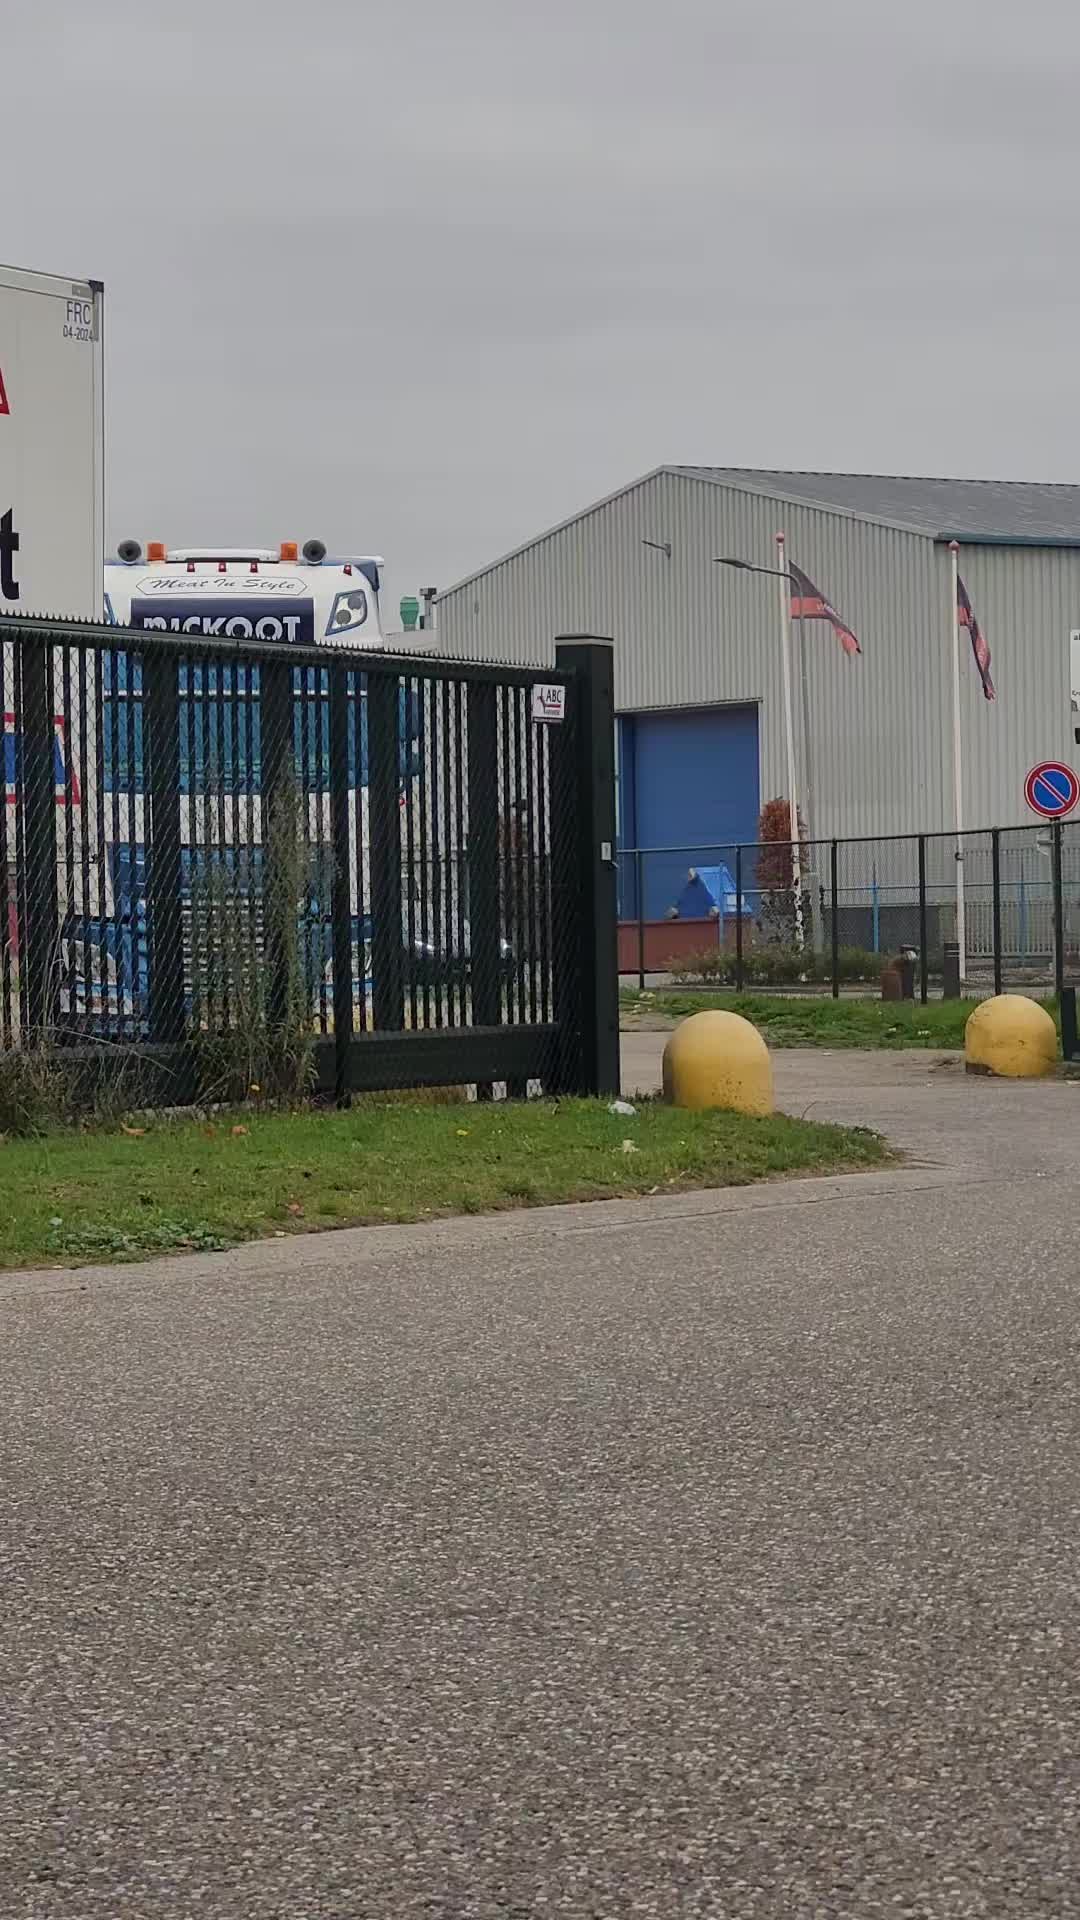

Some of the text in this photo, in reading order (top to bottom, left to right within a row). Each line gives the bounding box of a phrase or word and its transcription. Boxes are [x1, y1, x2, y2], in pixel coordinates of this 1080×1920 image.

[66, 300, 92, 325] FRC
[150, 578, 296, 591] Meat In Style
[546, 688, 562, 704] ABC
